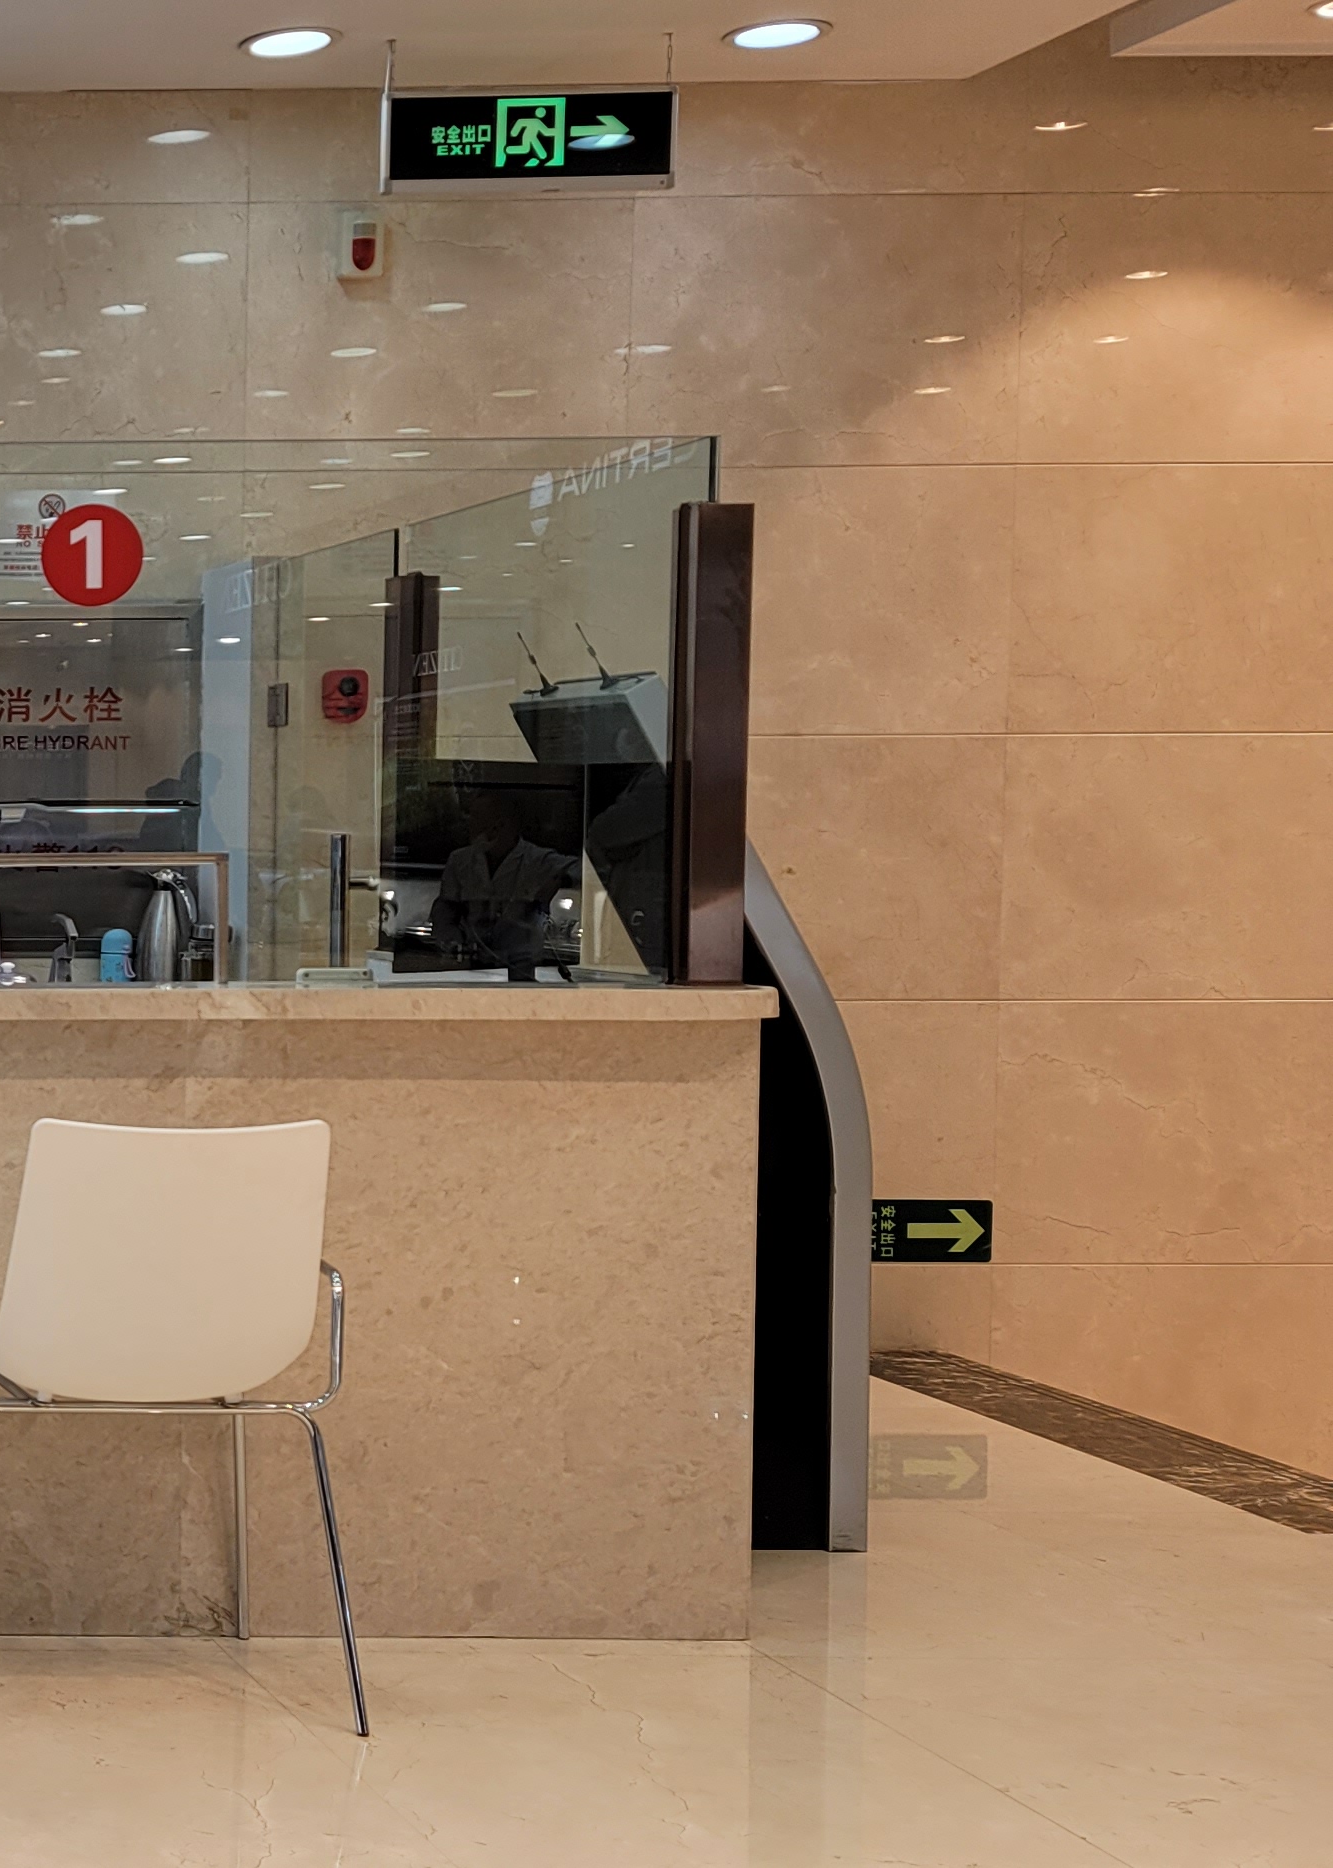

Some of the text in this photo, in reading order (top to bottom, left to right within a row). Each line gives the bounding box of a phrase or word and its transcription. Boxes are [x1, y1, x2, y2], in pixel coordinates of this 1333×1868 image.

[431, 125, 492, 144] 安全出口
[436, 144, 485, 156] EXIT
[16, 524, 49, 540] 禁止
[70, 519, 103, 589] 1
[34, 735, 131, 751] HYDRANT
[880, 1205, 897, 1258] 安全出口
